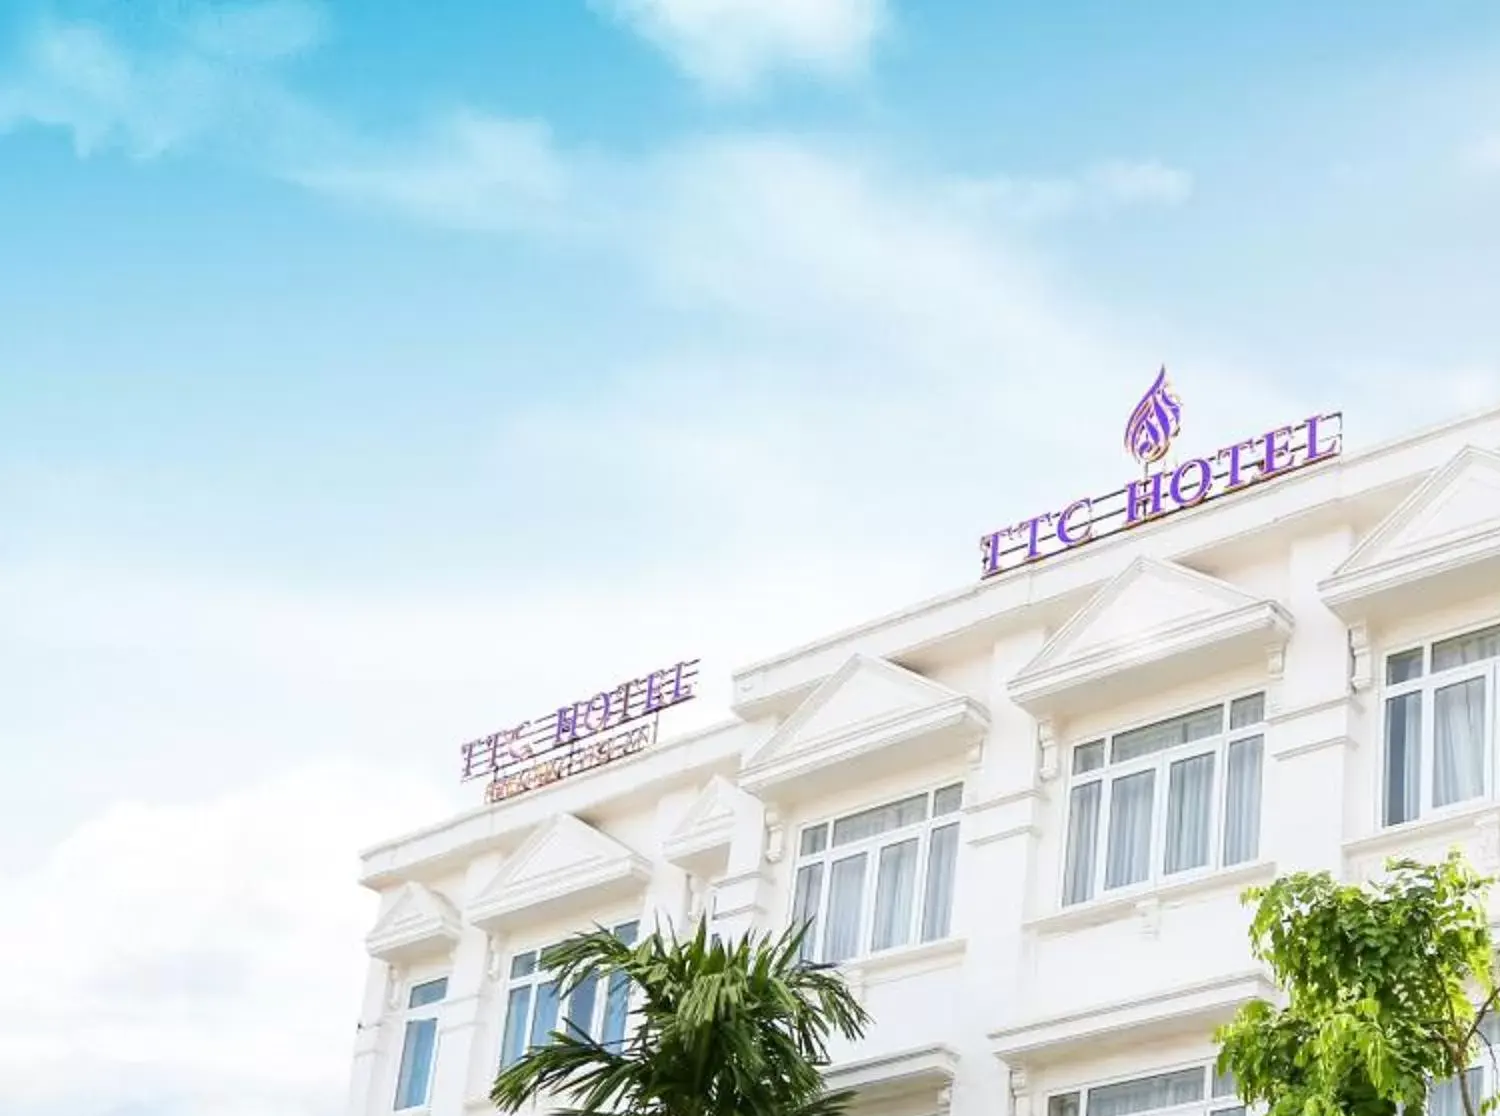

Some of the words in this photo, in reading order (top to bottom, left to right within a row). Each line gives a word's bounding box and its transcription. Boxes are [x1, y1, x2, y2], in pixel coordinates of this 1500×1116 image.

[980, 498, 1092, 575] TTC
[1123, 413, 1337, 524] HOTEL
[461, 721, 533, 778] TTC
[553, 661, 692, 744] HOTEL
